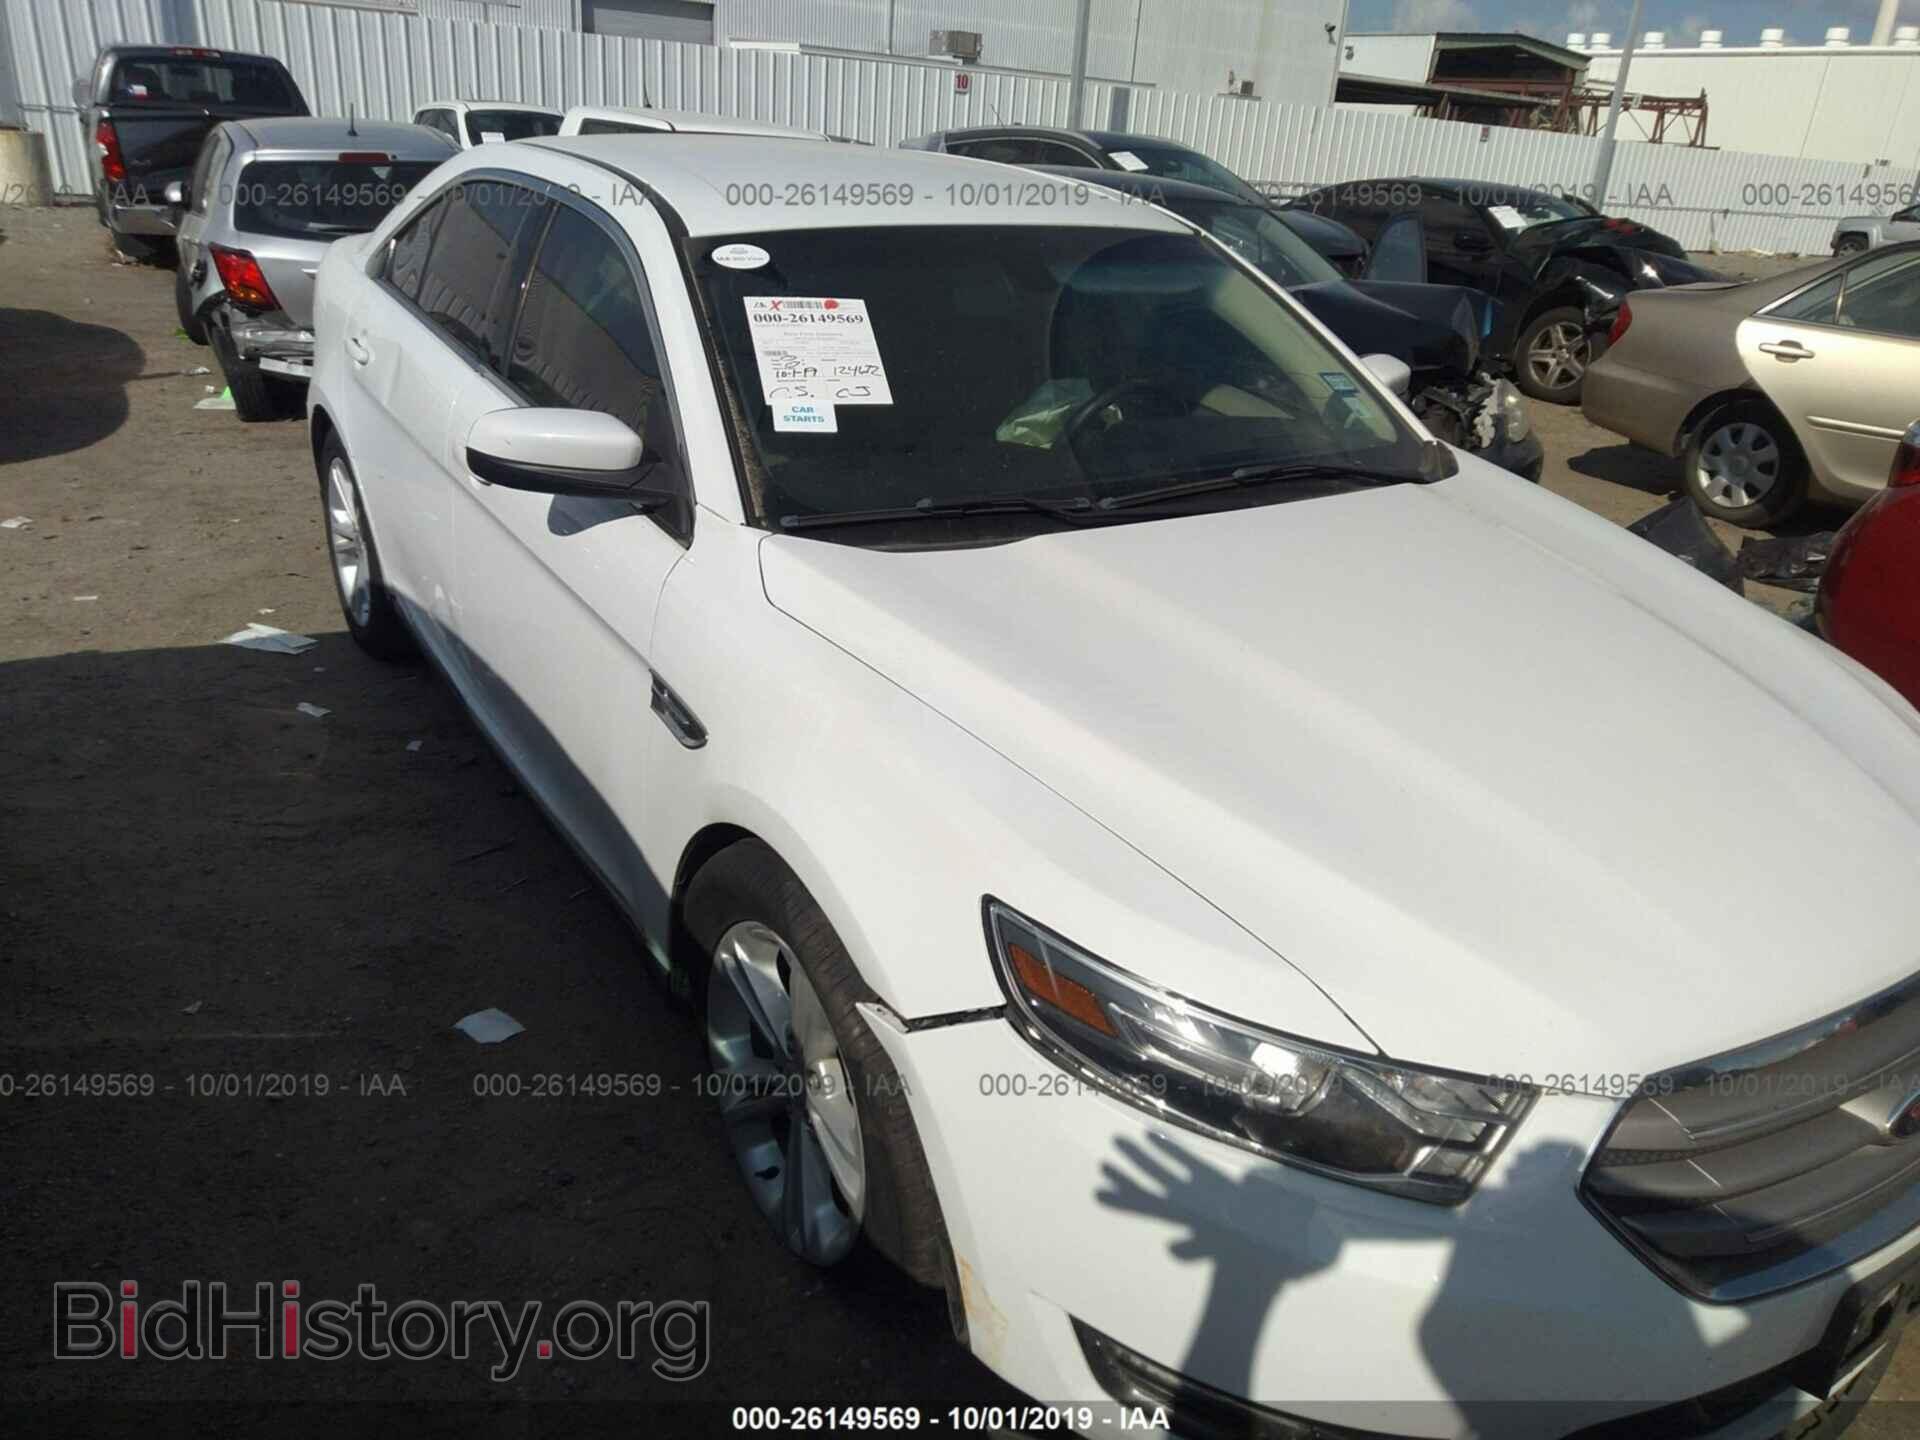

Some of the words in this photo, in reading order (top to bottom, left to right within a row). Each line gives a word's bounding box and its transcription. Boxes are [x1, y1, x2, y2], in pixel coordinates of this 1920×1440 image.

[956, 74, 969, 89] 10
[753, 313, 864, 324] 000-26149569
[783, 415, 825, 423] STARTS
